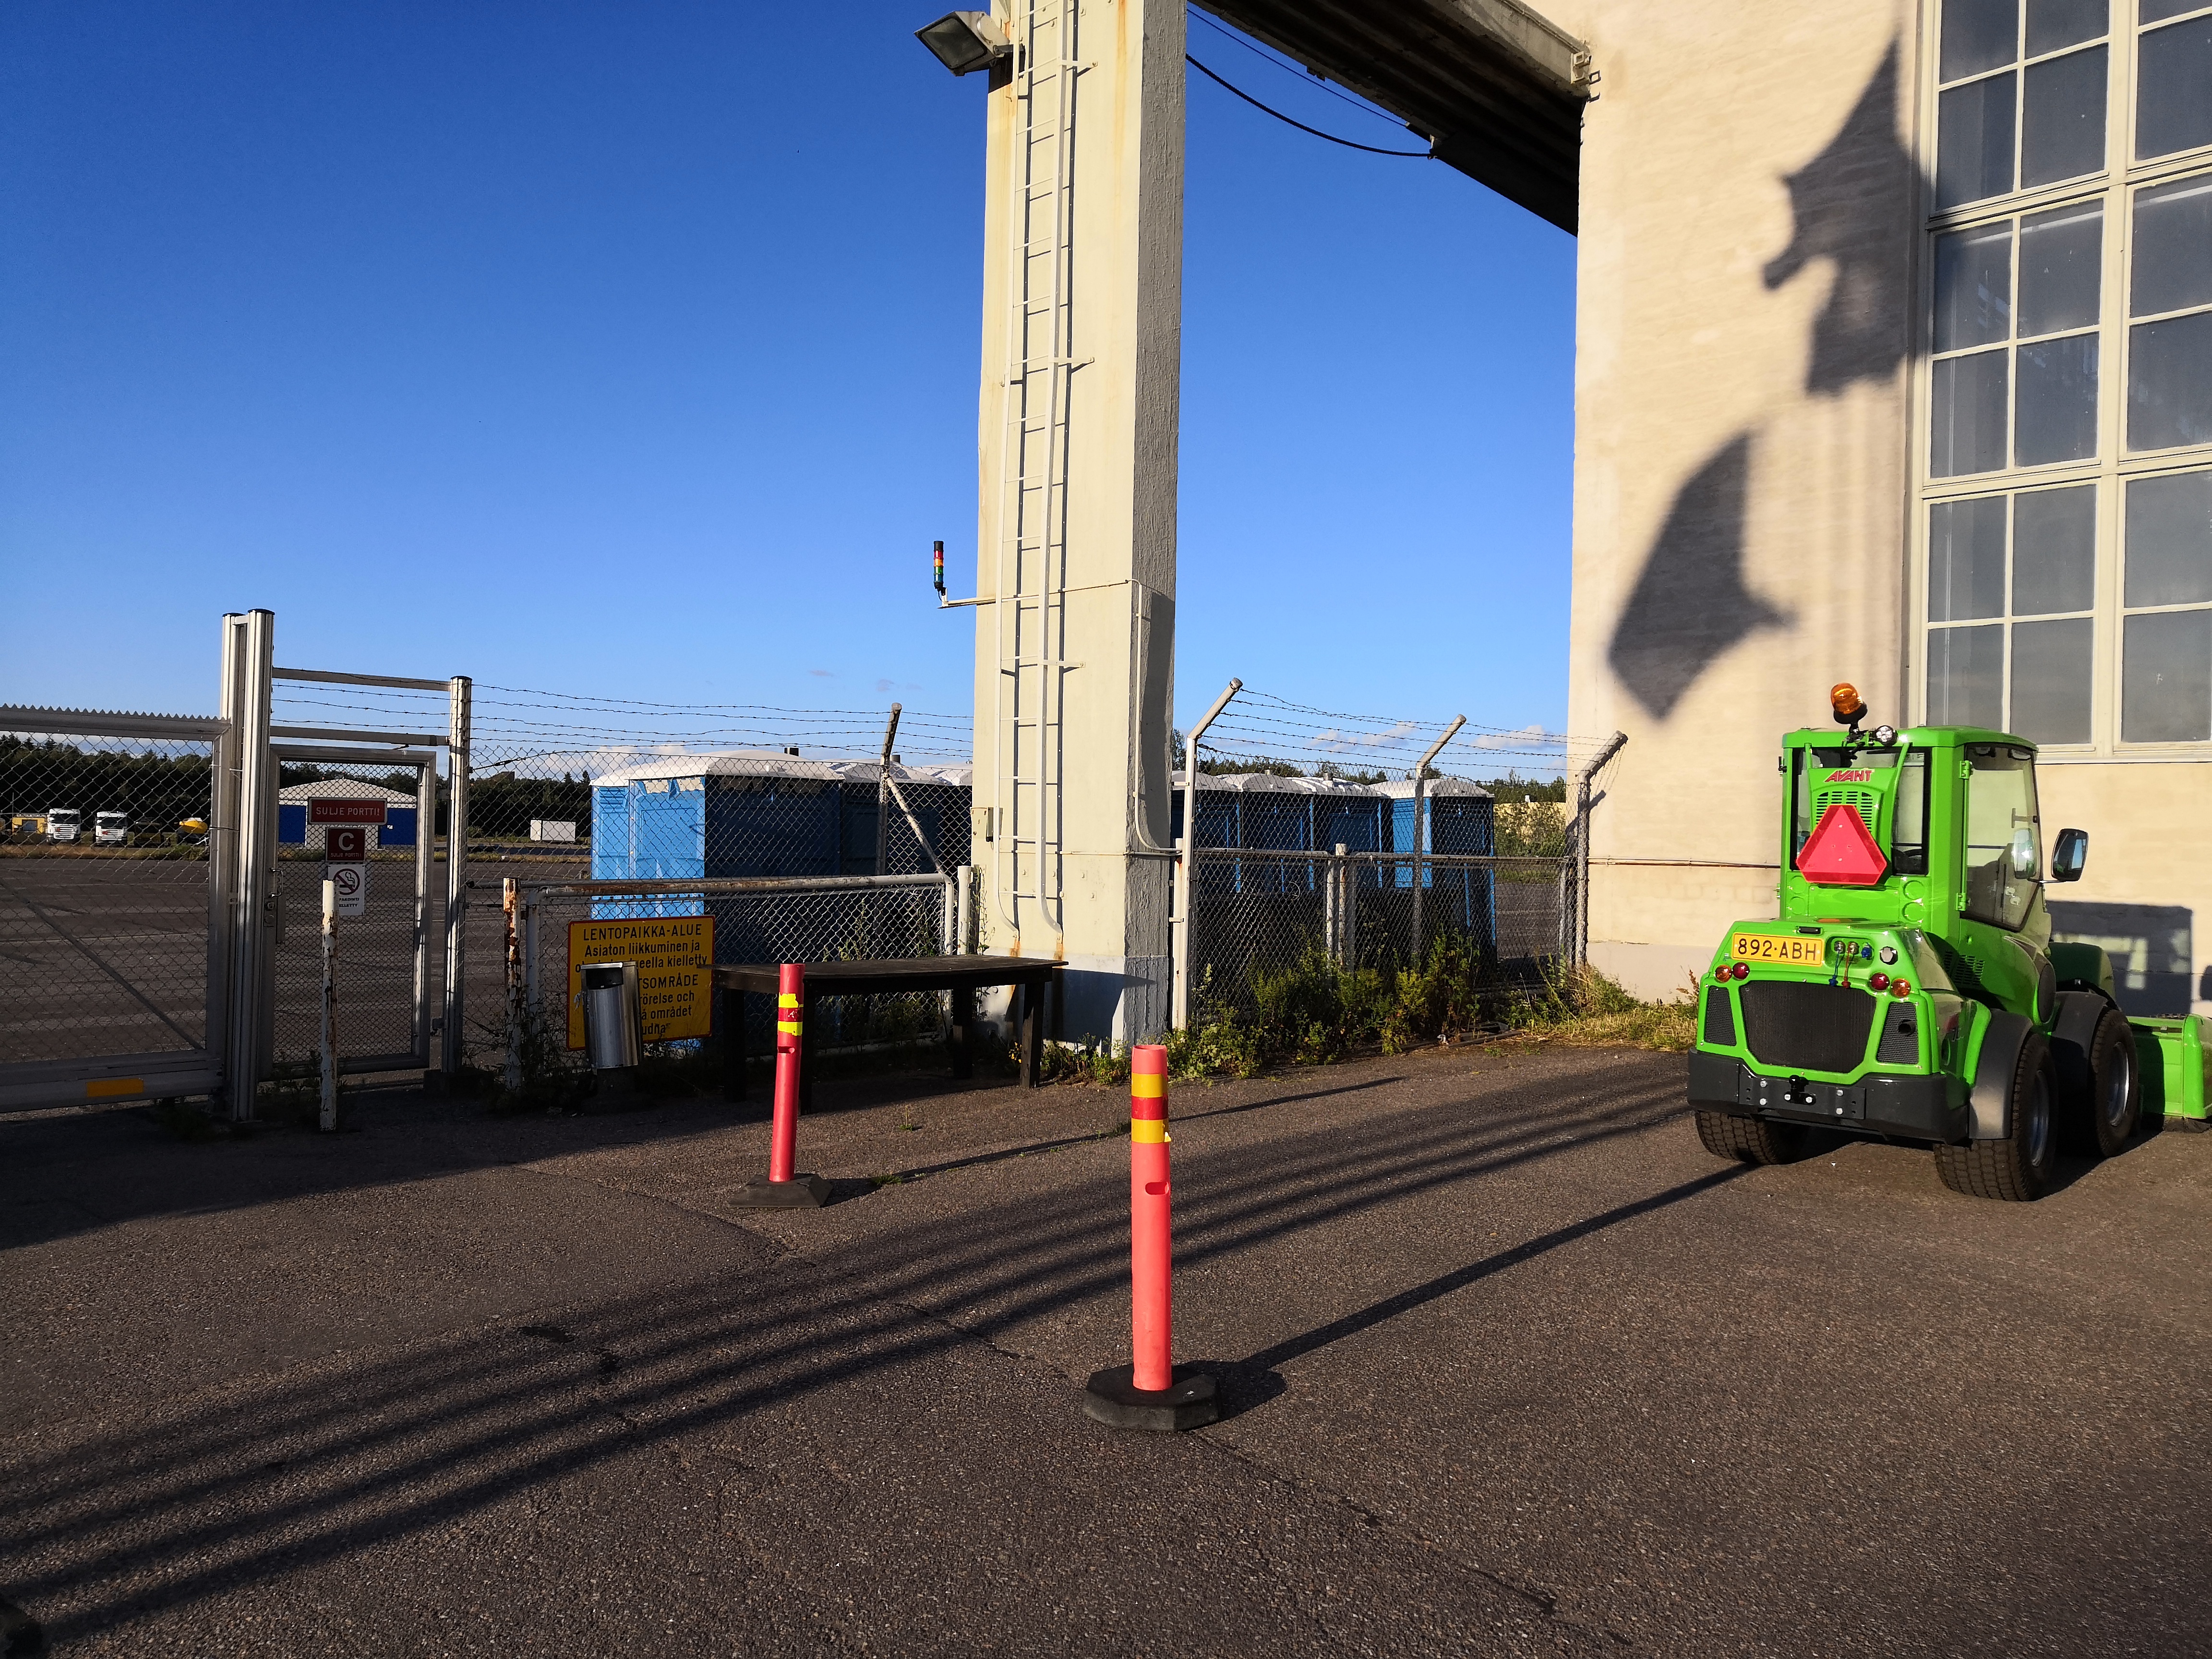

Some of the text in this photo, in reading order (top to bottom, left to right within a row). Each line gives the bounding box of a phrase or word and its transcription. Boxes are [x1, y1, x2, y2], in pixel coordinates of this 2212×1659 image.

[1824, 770, 1872, 782] AVANT
[316, 807, 380, 816] SULJE PORTTI!
[338, 832, 354, 851] C
[583, 924, 702, 941] LENTOPAIKKA-ALUE
[585, 939, 700, 957] Asiaton liikkuminen ja
[667, 954, 707, 967] kielletty
[677, 990, 695, 1002] och
[650, 1005, 692, 1019] området
